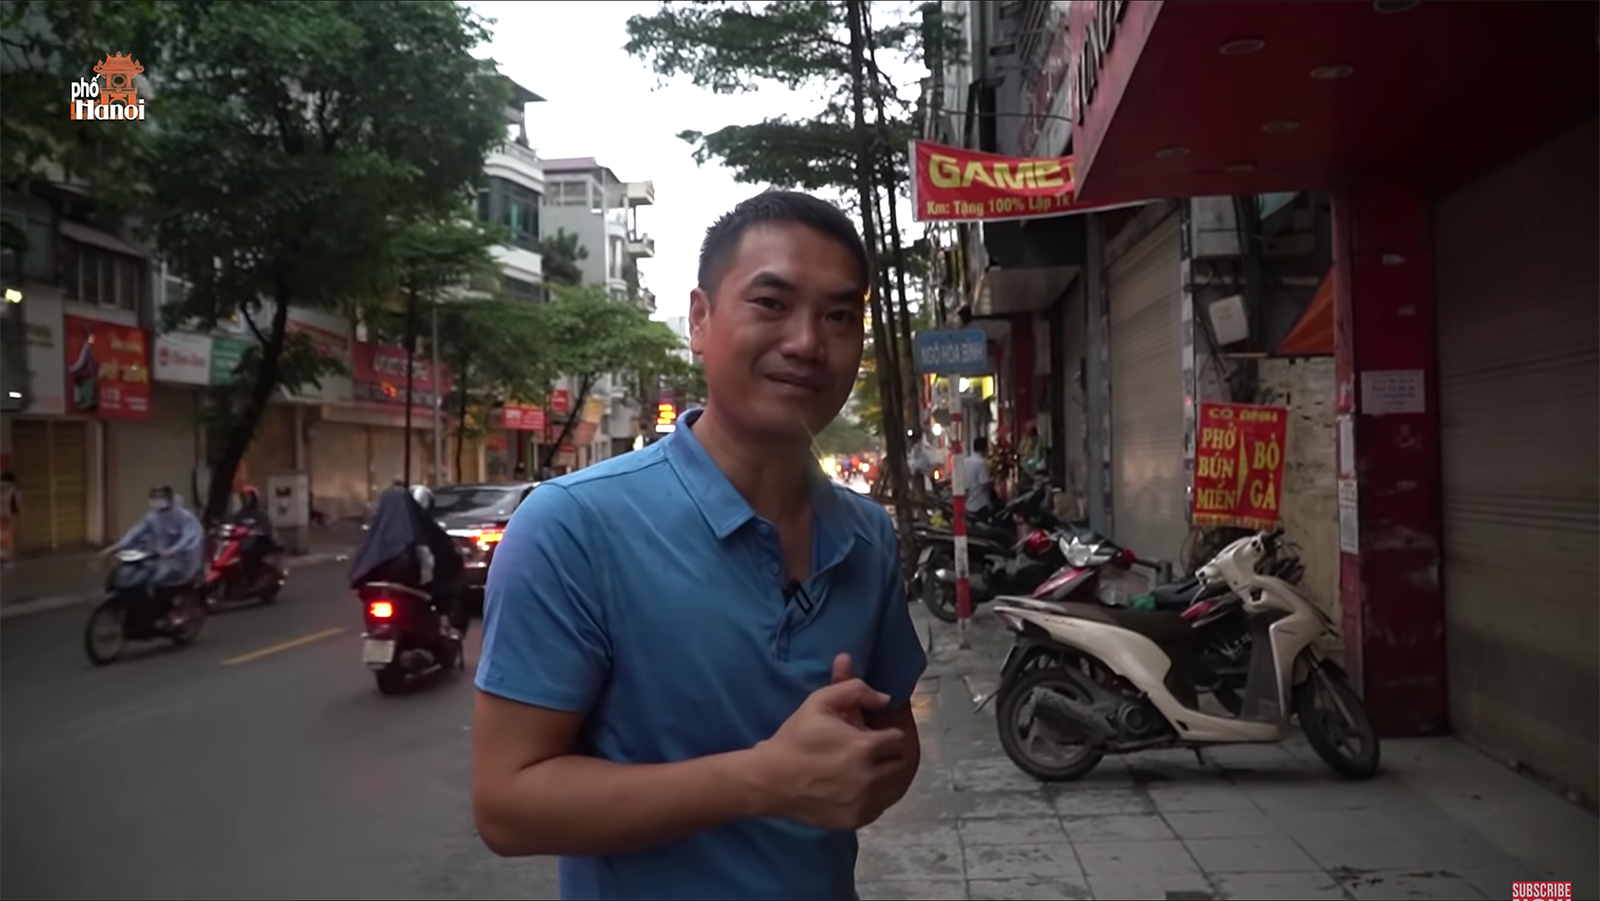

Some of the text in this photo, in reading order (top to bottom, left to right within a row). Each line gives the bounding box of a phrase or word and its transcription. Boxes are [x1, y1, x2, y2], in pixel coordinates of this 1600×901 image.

[927, 201, 950, 215] Km:
[988, 197, 1025, 213] 100%
[1201, 421, 1237, 450] PHỞ
[1197, 451, 1234, 479] BÚN
[1253, 433, 1280, 470] BÒ
[1250, 472, 1277, 510] GÀ
